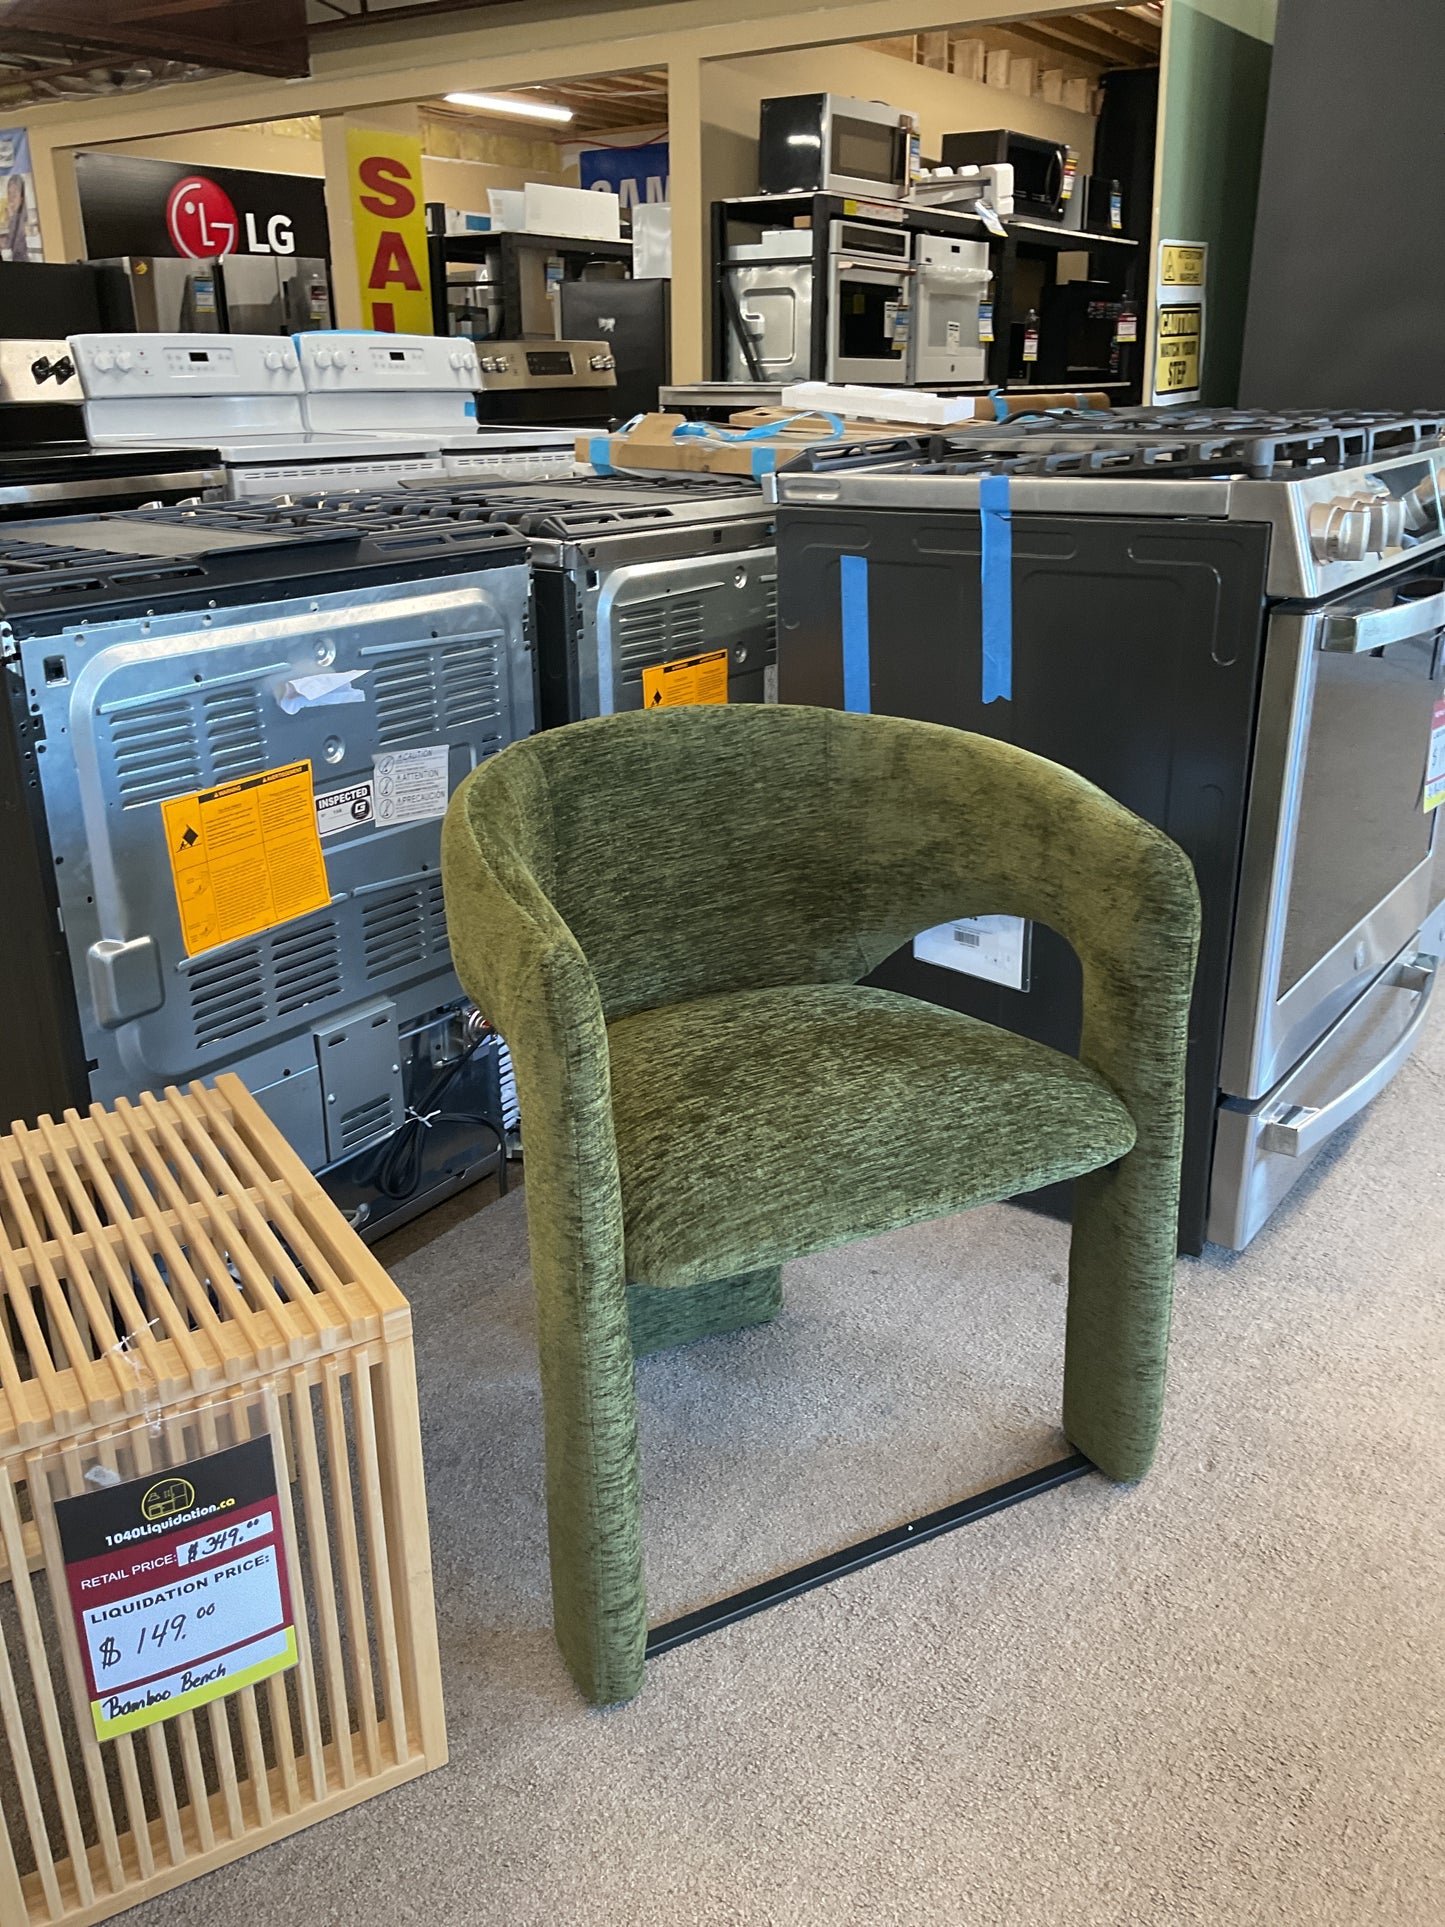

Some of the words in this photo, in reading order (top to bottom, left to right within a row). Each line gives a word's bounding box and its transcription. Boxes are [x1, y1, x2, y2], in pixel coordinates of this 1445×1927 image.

[245, 212, 296, 255] LG
[1167, 360, 1187, 387] STEP
[403, 749, 433, 761] CAUTION
[403, 769, 439, 781] ATTENTION
[318, 786, 368, 810] INSPECTED
[104, 1496, 235, 1547] 1040Liquidation.ca
[80, 1569, 129, 1590] RETAIL
[132, 1553, 177, 1575] PRICE:
[91, 1577, 209, 1624] LIQUIDATION
[214, 1555, 270, 1582] PRICE:
[102, 1689, 171, 1720] Bamboo
[181, 1663, 226, 1693] Bench
